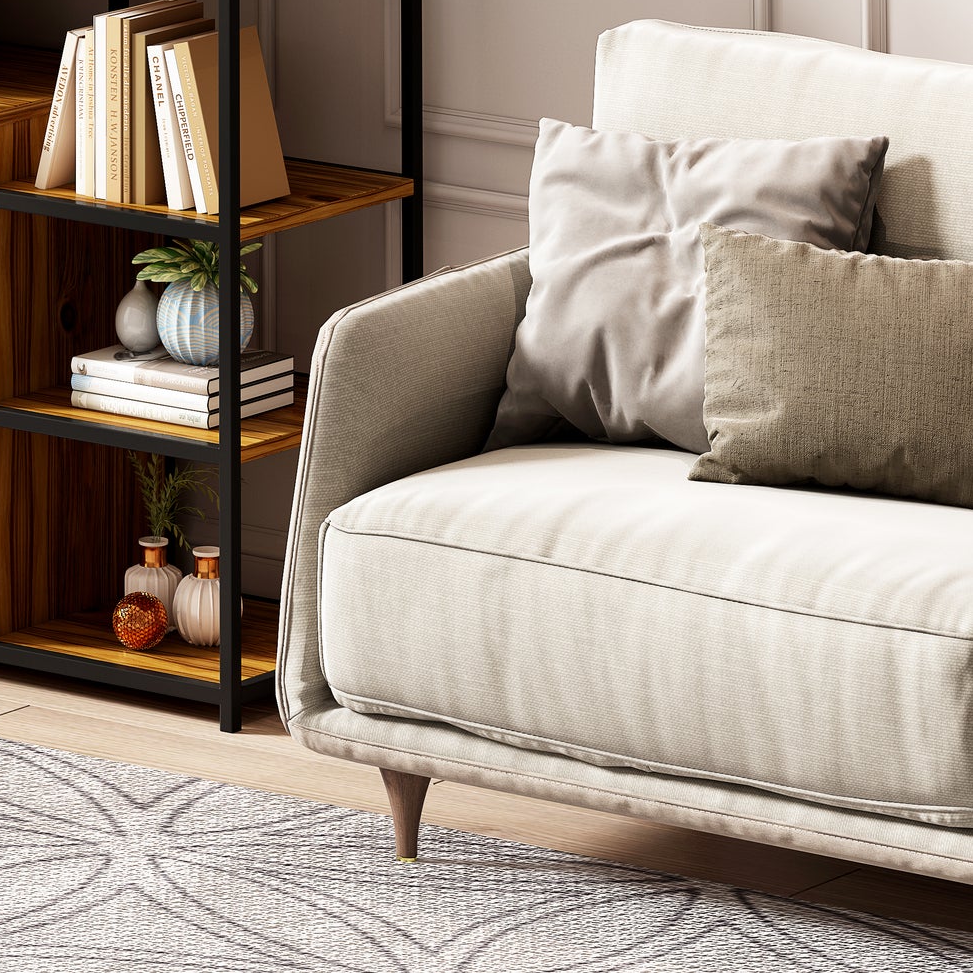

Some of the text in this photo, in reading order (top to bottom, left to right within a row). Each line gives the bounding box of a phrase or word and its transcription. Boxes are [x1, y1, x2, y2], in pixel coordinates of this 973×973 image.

[43, 63, 69, 152] AVEDON advertising
[109, 49, 118, 180] KONSTEN H.W.JANSON
[152, 56, 165, 107] CHANEL
[181, 56, 192, 95] VICTORIA
[196, 126, 205, 157] INTERIOR
[203, 155, 213, 196] PORTRAITS
[175, 93, 194, 161] CHIPPERFIELD
